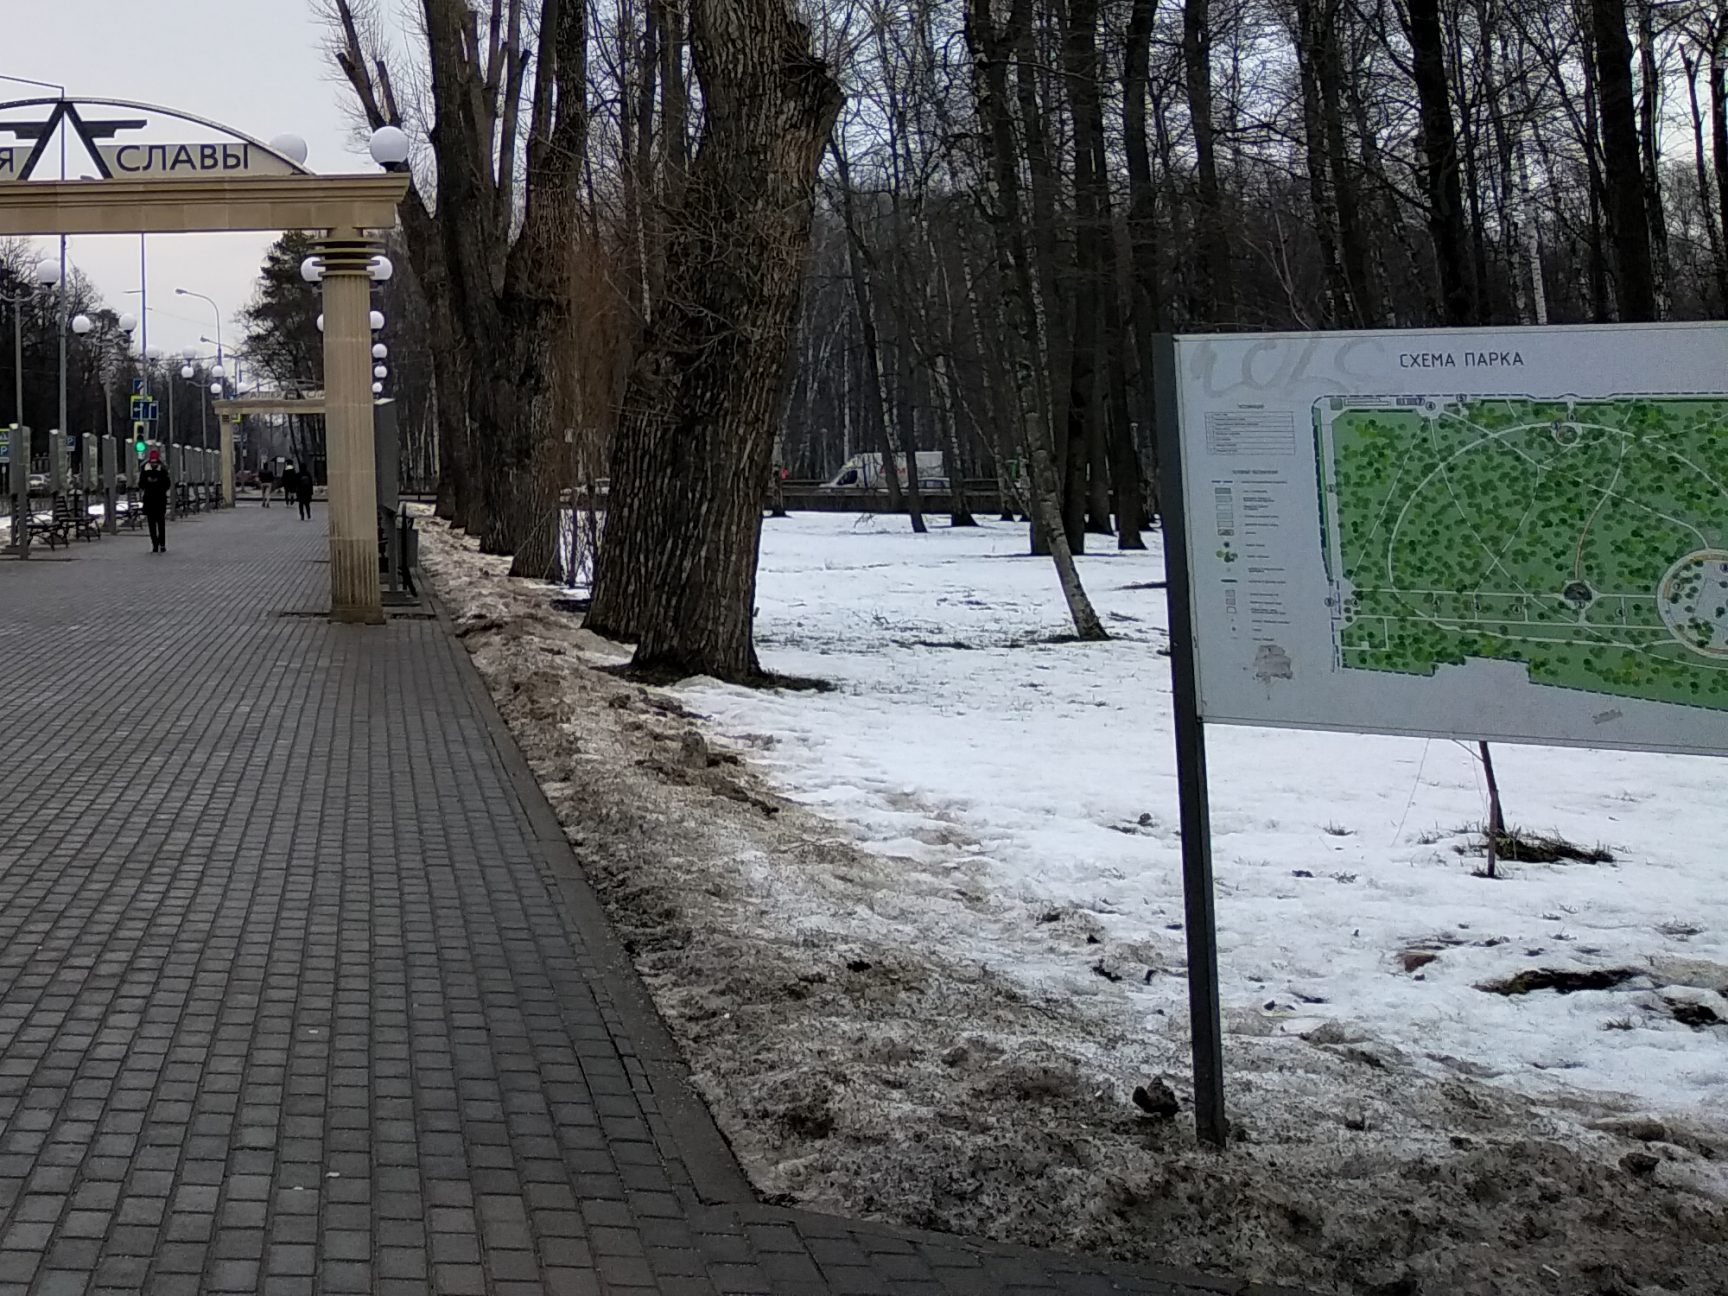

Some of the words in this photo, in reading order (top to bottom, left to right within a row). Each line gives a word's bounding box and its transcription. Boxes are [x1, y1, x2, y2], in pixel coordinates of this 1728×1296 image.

[116, 143, 250, 173] СЛАВЫ
[1399, 353, 1456, 368] СХЕМА
[1464, 351, 1525, 367] ПАРКА
[0, 445, 8, 456] P
